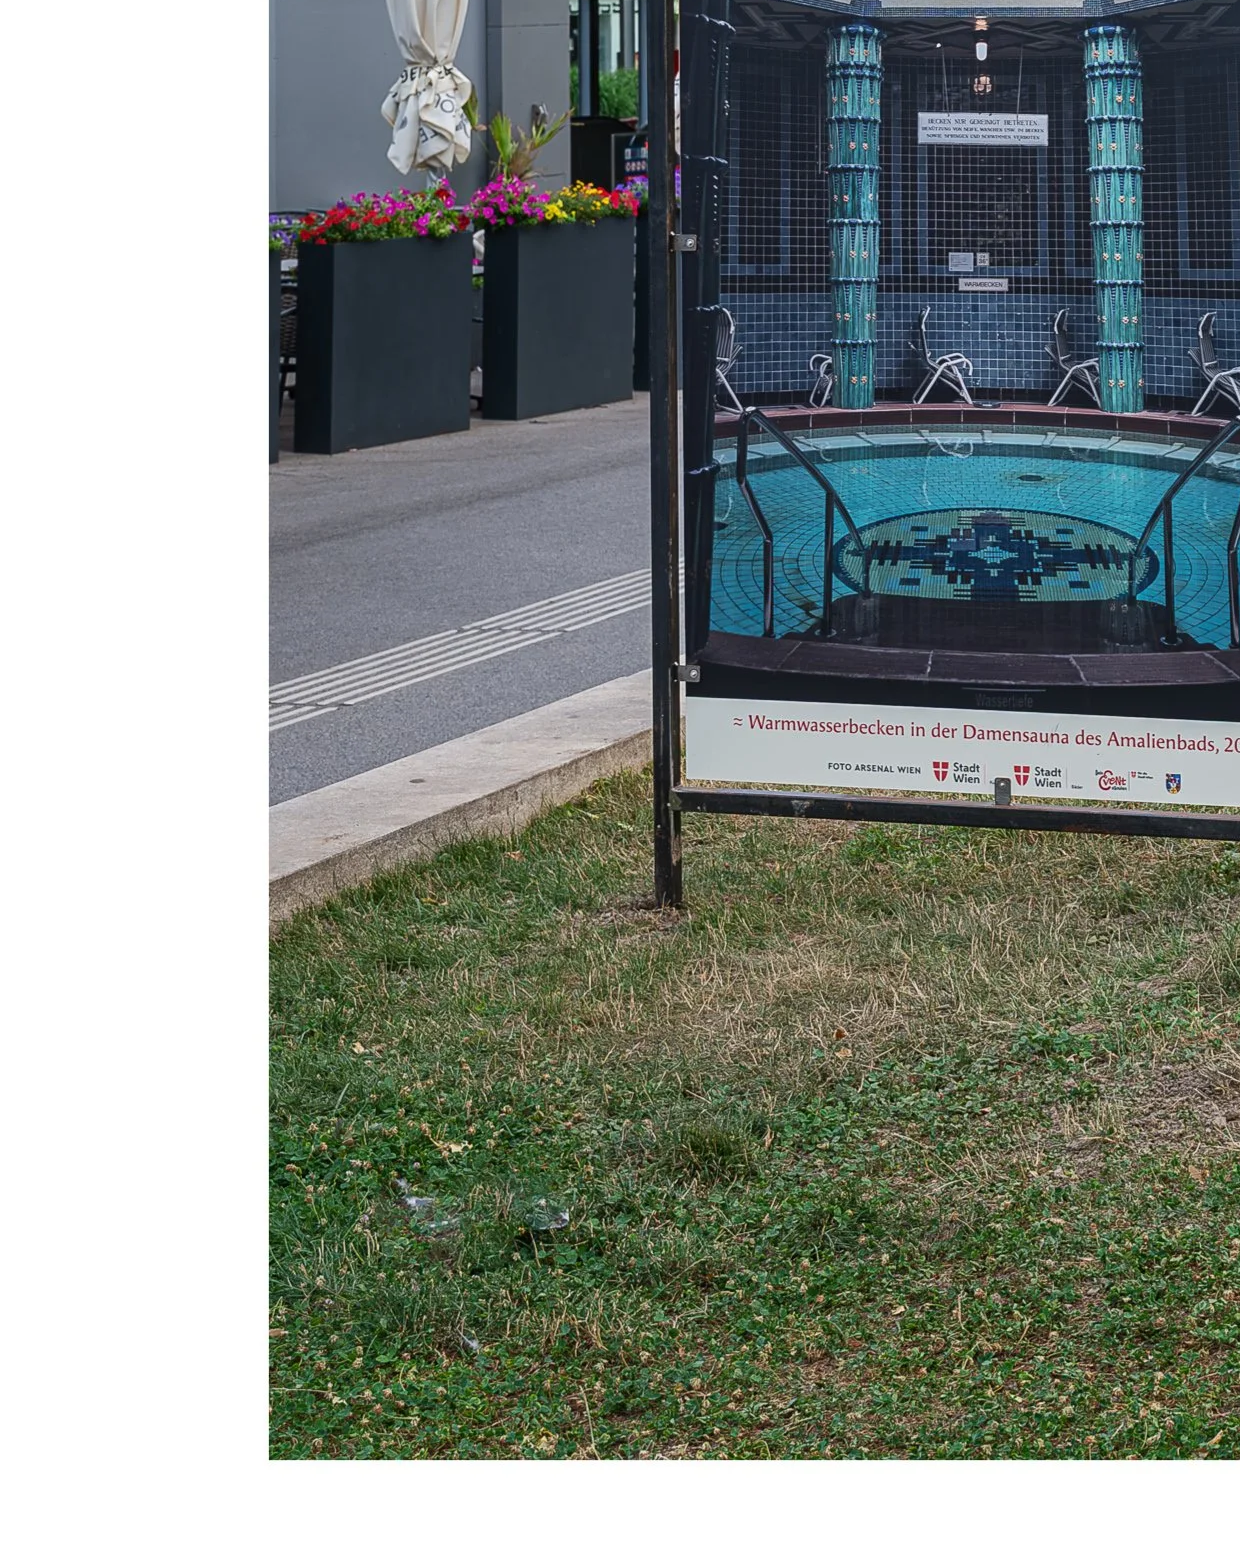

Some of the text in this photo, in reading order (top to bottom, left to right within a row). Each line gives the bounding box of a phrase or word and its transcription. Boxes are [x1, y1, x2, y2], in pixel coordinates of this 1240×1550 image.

[748, 712, 904, 737] Warmwasserbecken
[911, 722, 925, 737] in
[931, 722, 957, 739] der
[964, 724, 1068, 744] Damensauna
[1075, 730, 1101, 746] des
[1107, 732, 1219, 754] Amalienbads,
[828, 762, 921, 774] FOTO ARSENAL WIEN
[953, 762, 980, 775] Stadt
[1034, 766, 1061, 779] Stadt
[953, 773, 980, 784] Wien
[1034, 777, 1061, 788] Wien
